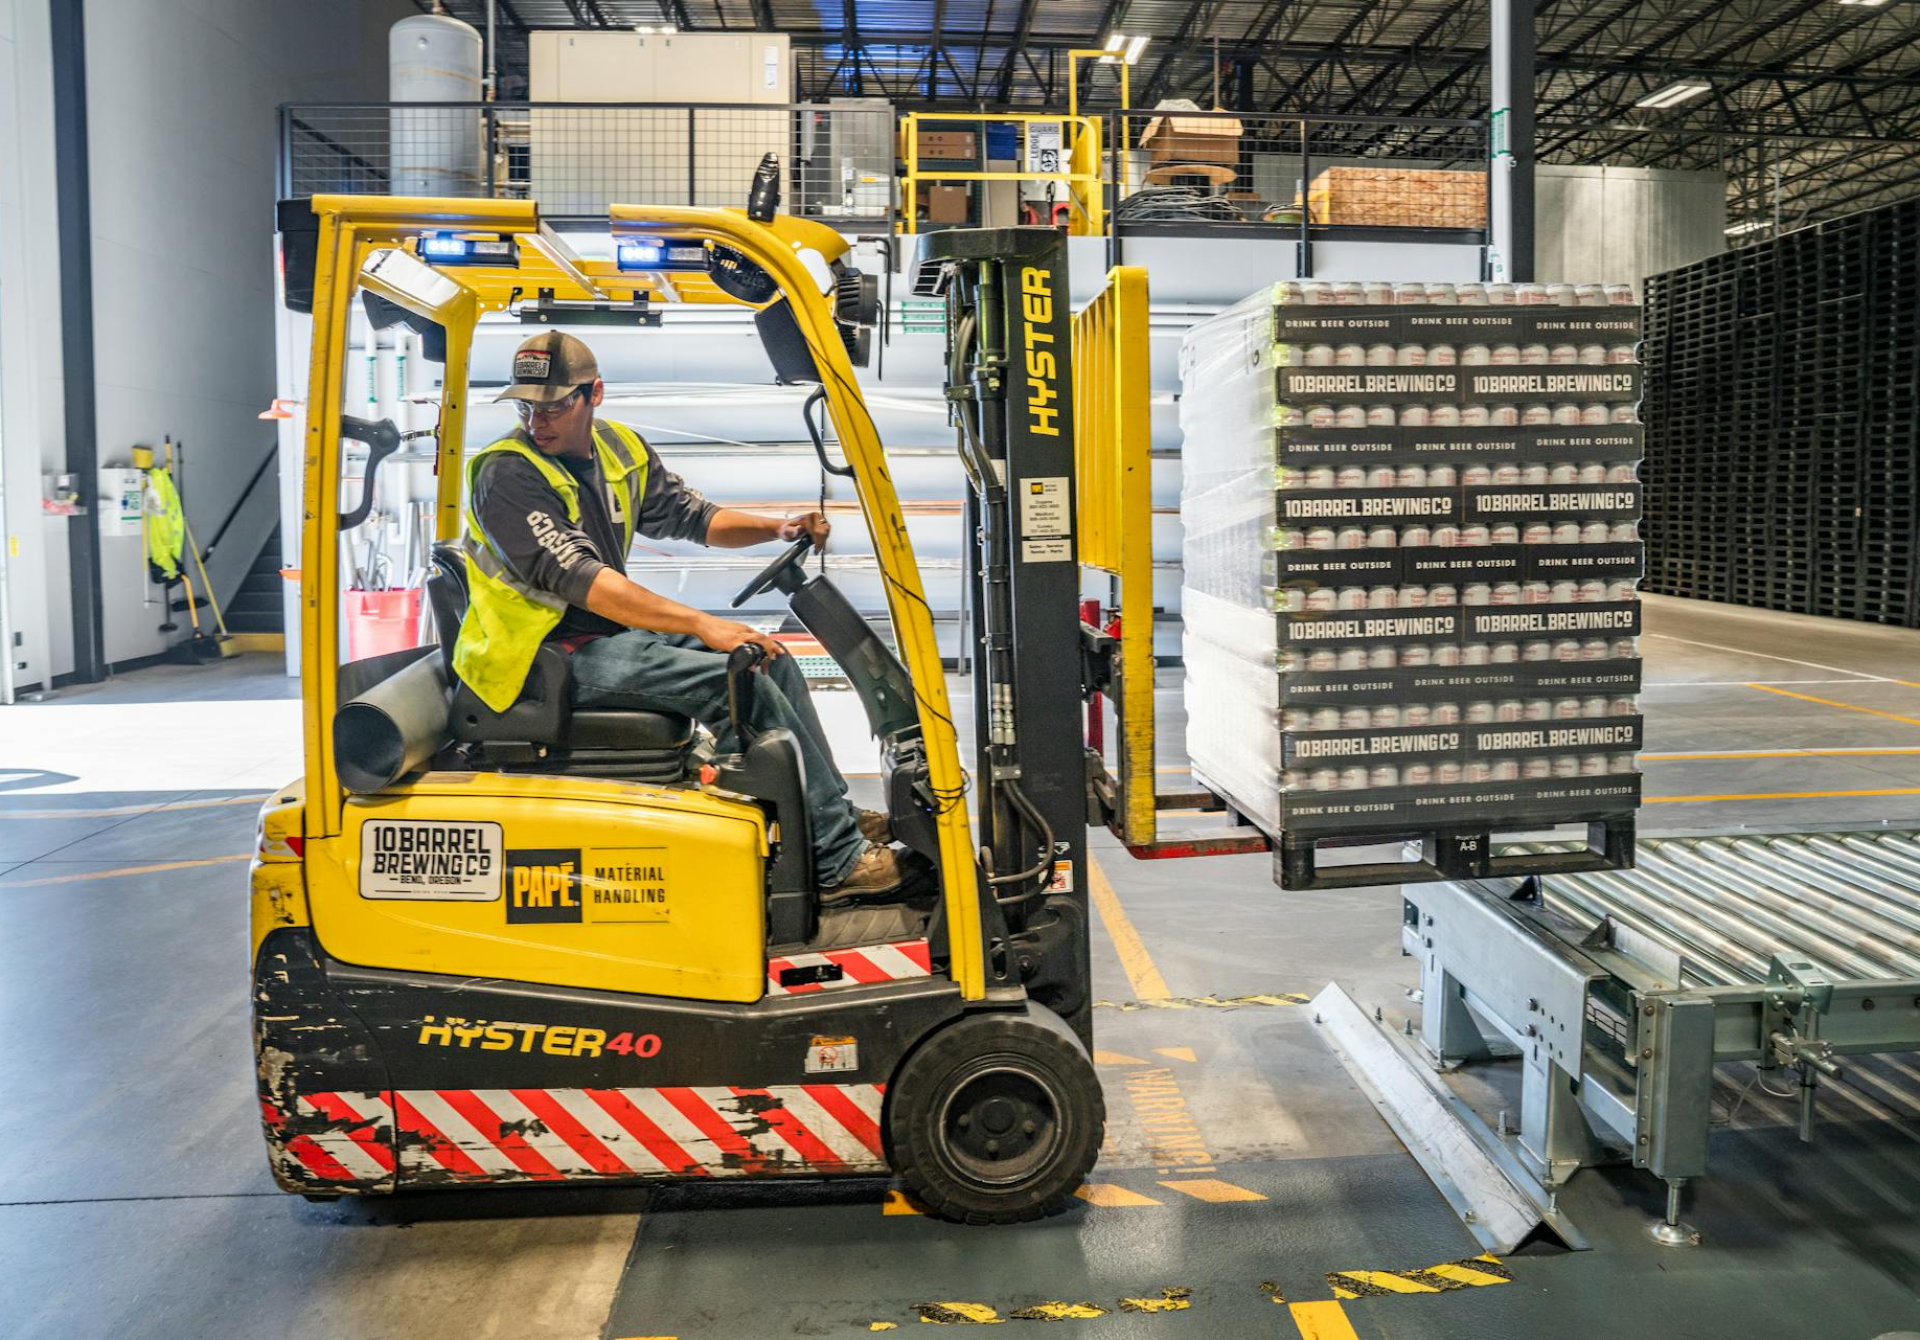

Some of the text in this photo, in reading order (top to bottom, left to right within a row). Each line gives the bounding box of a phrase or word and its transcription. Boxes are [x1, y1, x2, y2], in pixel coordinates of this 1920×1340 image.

[1030, 132, 1039, 159] LEDGE
[1285, 319, 1390, 328] DRINK BEER OUTSIDE
[1411, 317, 1513, 325] DRINK BEER OUTSIDE
[1536, 321, 1634, 330] DRINK BEER OUTSIDE
[1021, 266, 1060, 436] HYSTER
[1415, 442, 1516, 451] DRINK BEER OUTSIDE
[1536, 437, 1634, 446] DRINK BEER OUTSIDE
[1288, 443, 1392, 453] DRINK BEER OUTSIDE
[1287, 561, 1392, 572] DRINK BEER OUTSIDE
[1415, 559, 1516, 570] DRINK BEER OUTSIDE
[1538, 556, 1636, 567] DRINK BEER OUTSIDE
[1414, 675, 1514, 687] DRINK BEER OUTSIDE
[1537, 674, 1634, 686] DRINK BEER OUTSIDE
[1289, 681, 1393, 694] DRINK BEER OUTSIDE
[1536, 786, 1632, 799] DRINK BEER OUTSIDE
[1415, 793, 1515, 806] DRINK BEER OUTSIDE
[1291, 803, 1395, 816] DRINK BEER OUTSIDE
[1460, 840, 1478, 851] A-B
[594, 889, 665, 904] HANDLING
[606, 1032, 662, 1058] 40
